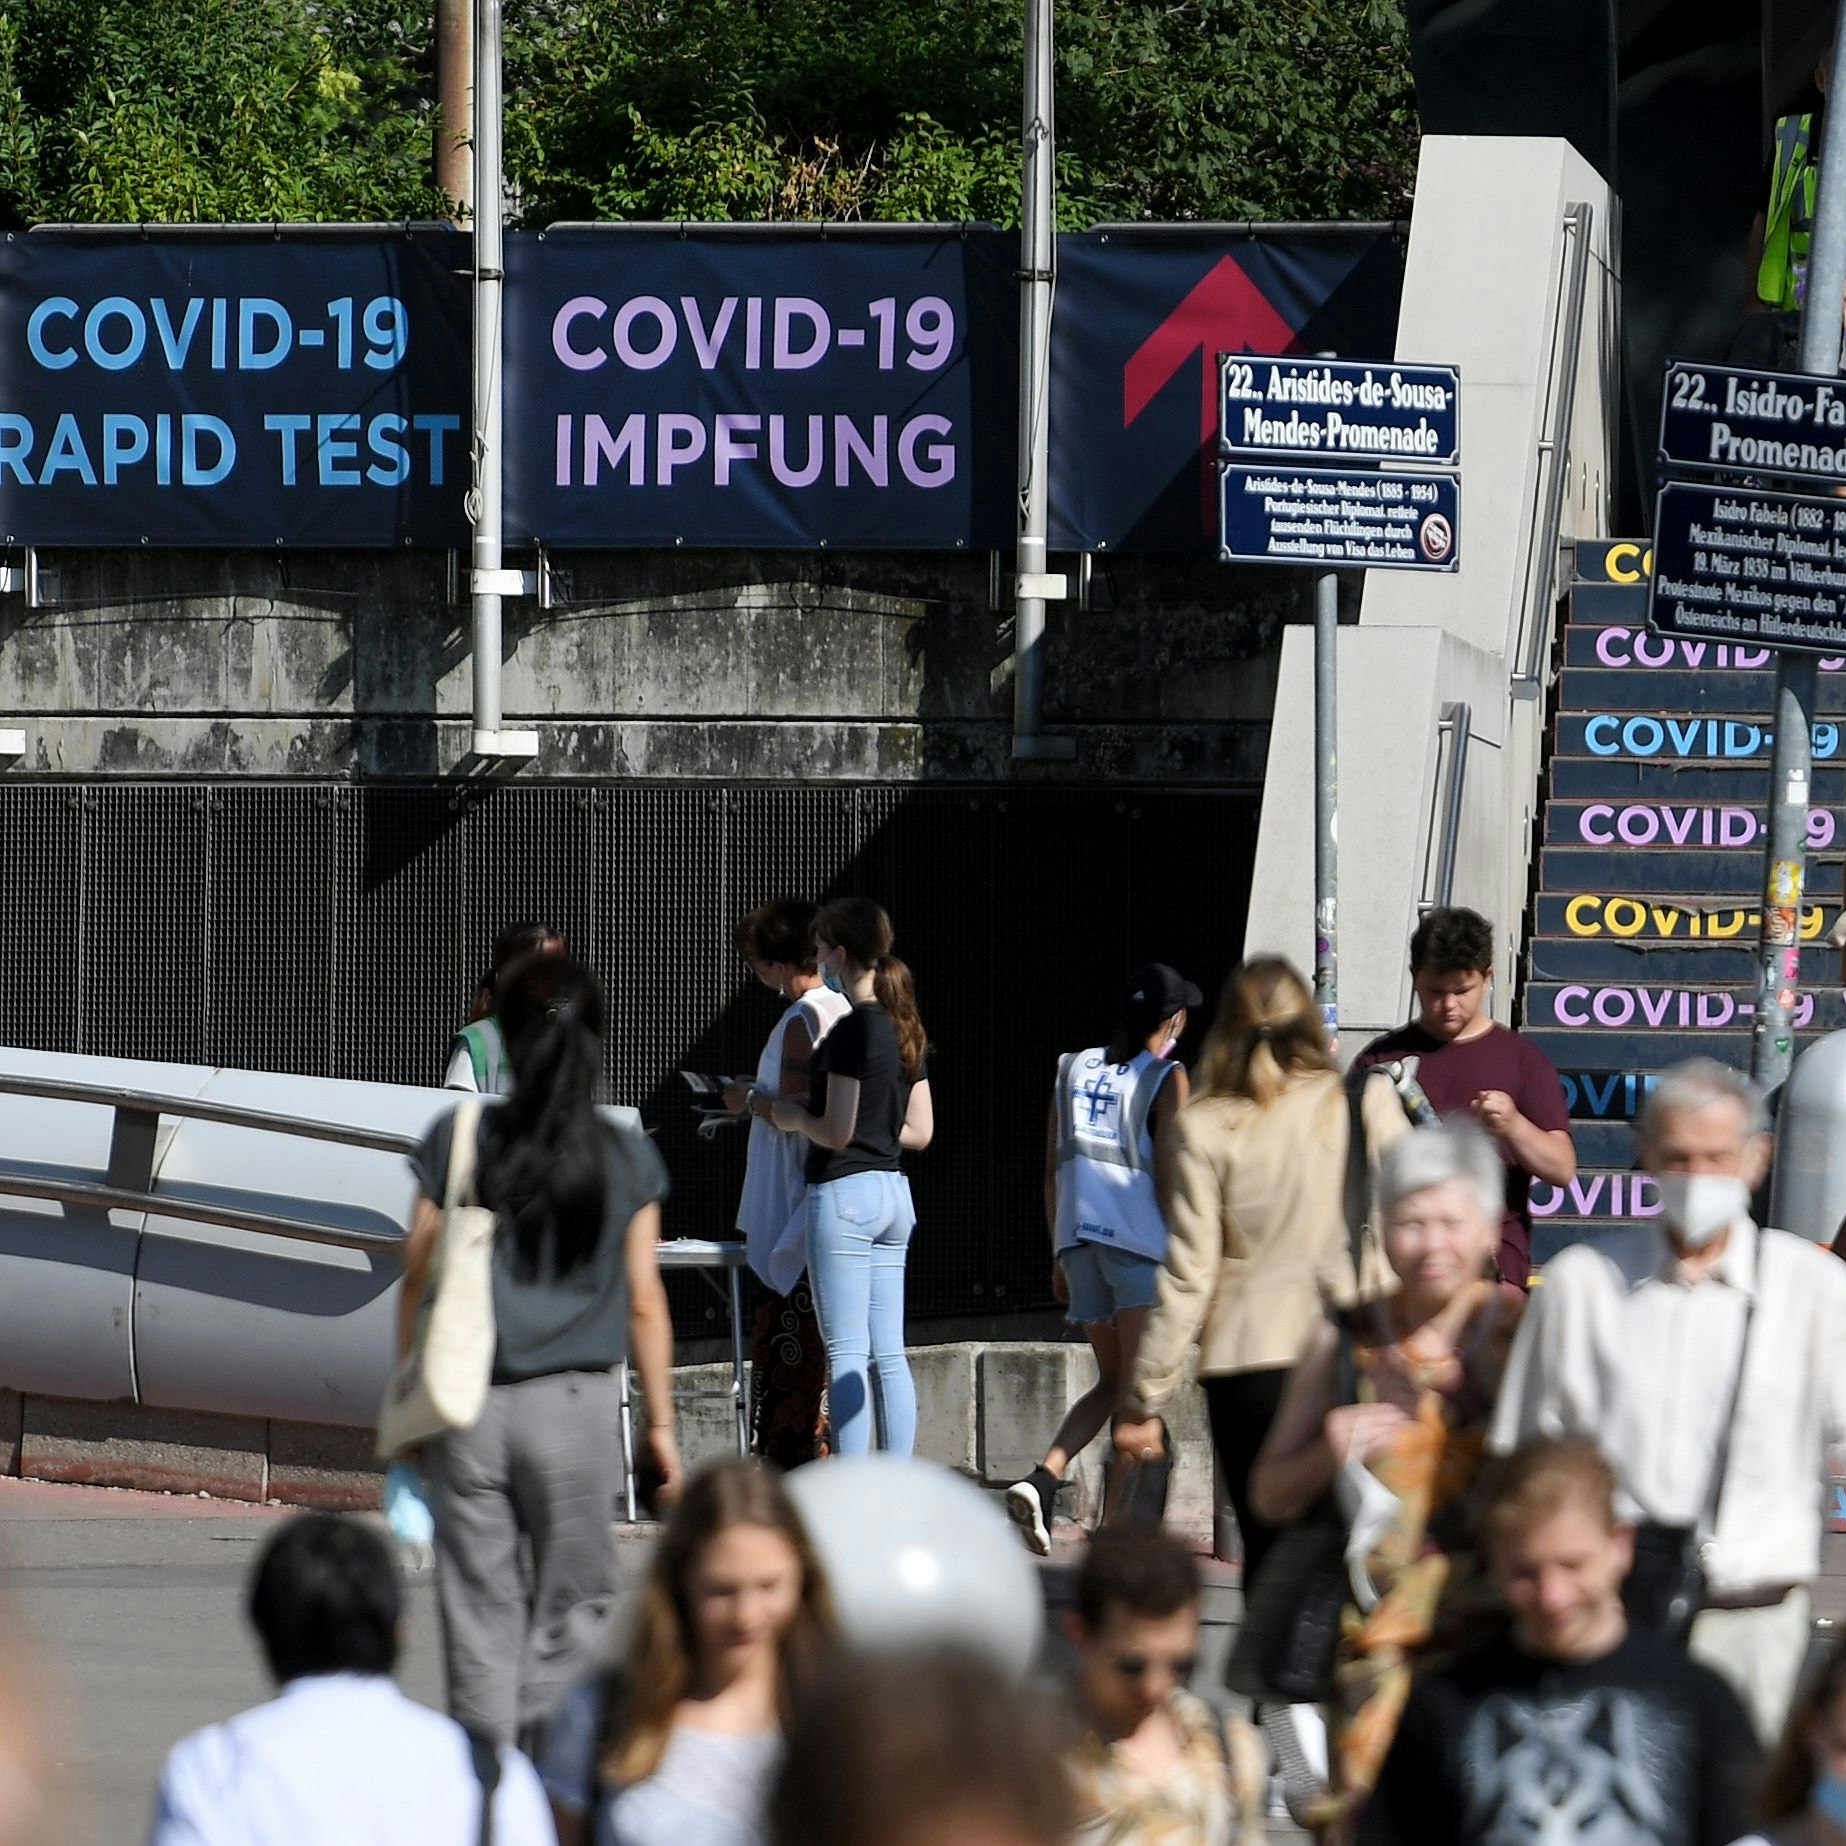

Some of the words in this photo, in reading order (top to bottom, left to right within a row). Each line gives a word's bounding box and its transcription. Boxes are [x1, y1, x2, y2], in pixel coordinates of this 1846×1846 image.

[27, 296, 409, 370] COVID-19
[552, 296, 955, 370] COVID-19
[1266, 365, 1453, 410] Aristides-de-Sousa-
[0, 413, 236, 486] RAPID
[264, 413, 460, 486] TEST
[556, 413, 956, 487] IMPFUNG
[1243, 407, 1439, 454] Mendes-Promenade
[1264, 496, 1339, 517] Portugiesischer
[1387, 505, 1419, 520] rettete
[1270, 518, 1322, 534] tausenden
[1323, 519, 1383, 540] Flüchtlingen
[1384, 522, 1413, 539] durch
[1713, 498, 1748, 520] Isidro
[1750, 501, 1788, 524] Fabela
[1790, 502, 1824, 531] (1882
[1267, 536, 1325, 557] Ausstellung
[1326, 543, 1344, 555] von
[1345, 540, 1366, 556] Visa
[1367, 541, 1384, 557] das
[1385, 542, 1416, 559] Leben
[1689, 522, 1775, 551] Mexikanischer
[1694, 551, 1709, 572] 19.
[1711, 552, 1741, 575] März
[1743, 556, 1769, 578] 1938
[1771, 560, 1787, 579] im
[1657, 574, 1723, 601] Protestnote
[1725, 581, 1773, 606] Mexikos
[1774, 593, 1810, 613] gegen
[1813, 591, 1836, 613] den
[1675, 601, 1741, 630] Österreichs
[1742, 617, 1758, 631] an
[1584, 715, 1839, 758] COVID-9
[1579, 804, 1836, 848] COVID-9
[1565, 894, 1824, 938] COVID-9
[1554, 985, 1815, 1028] COVID-9
